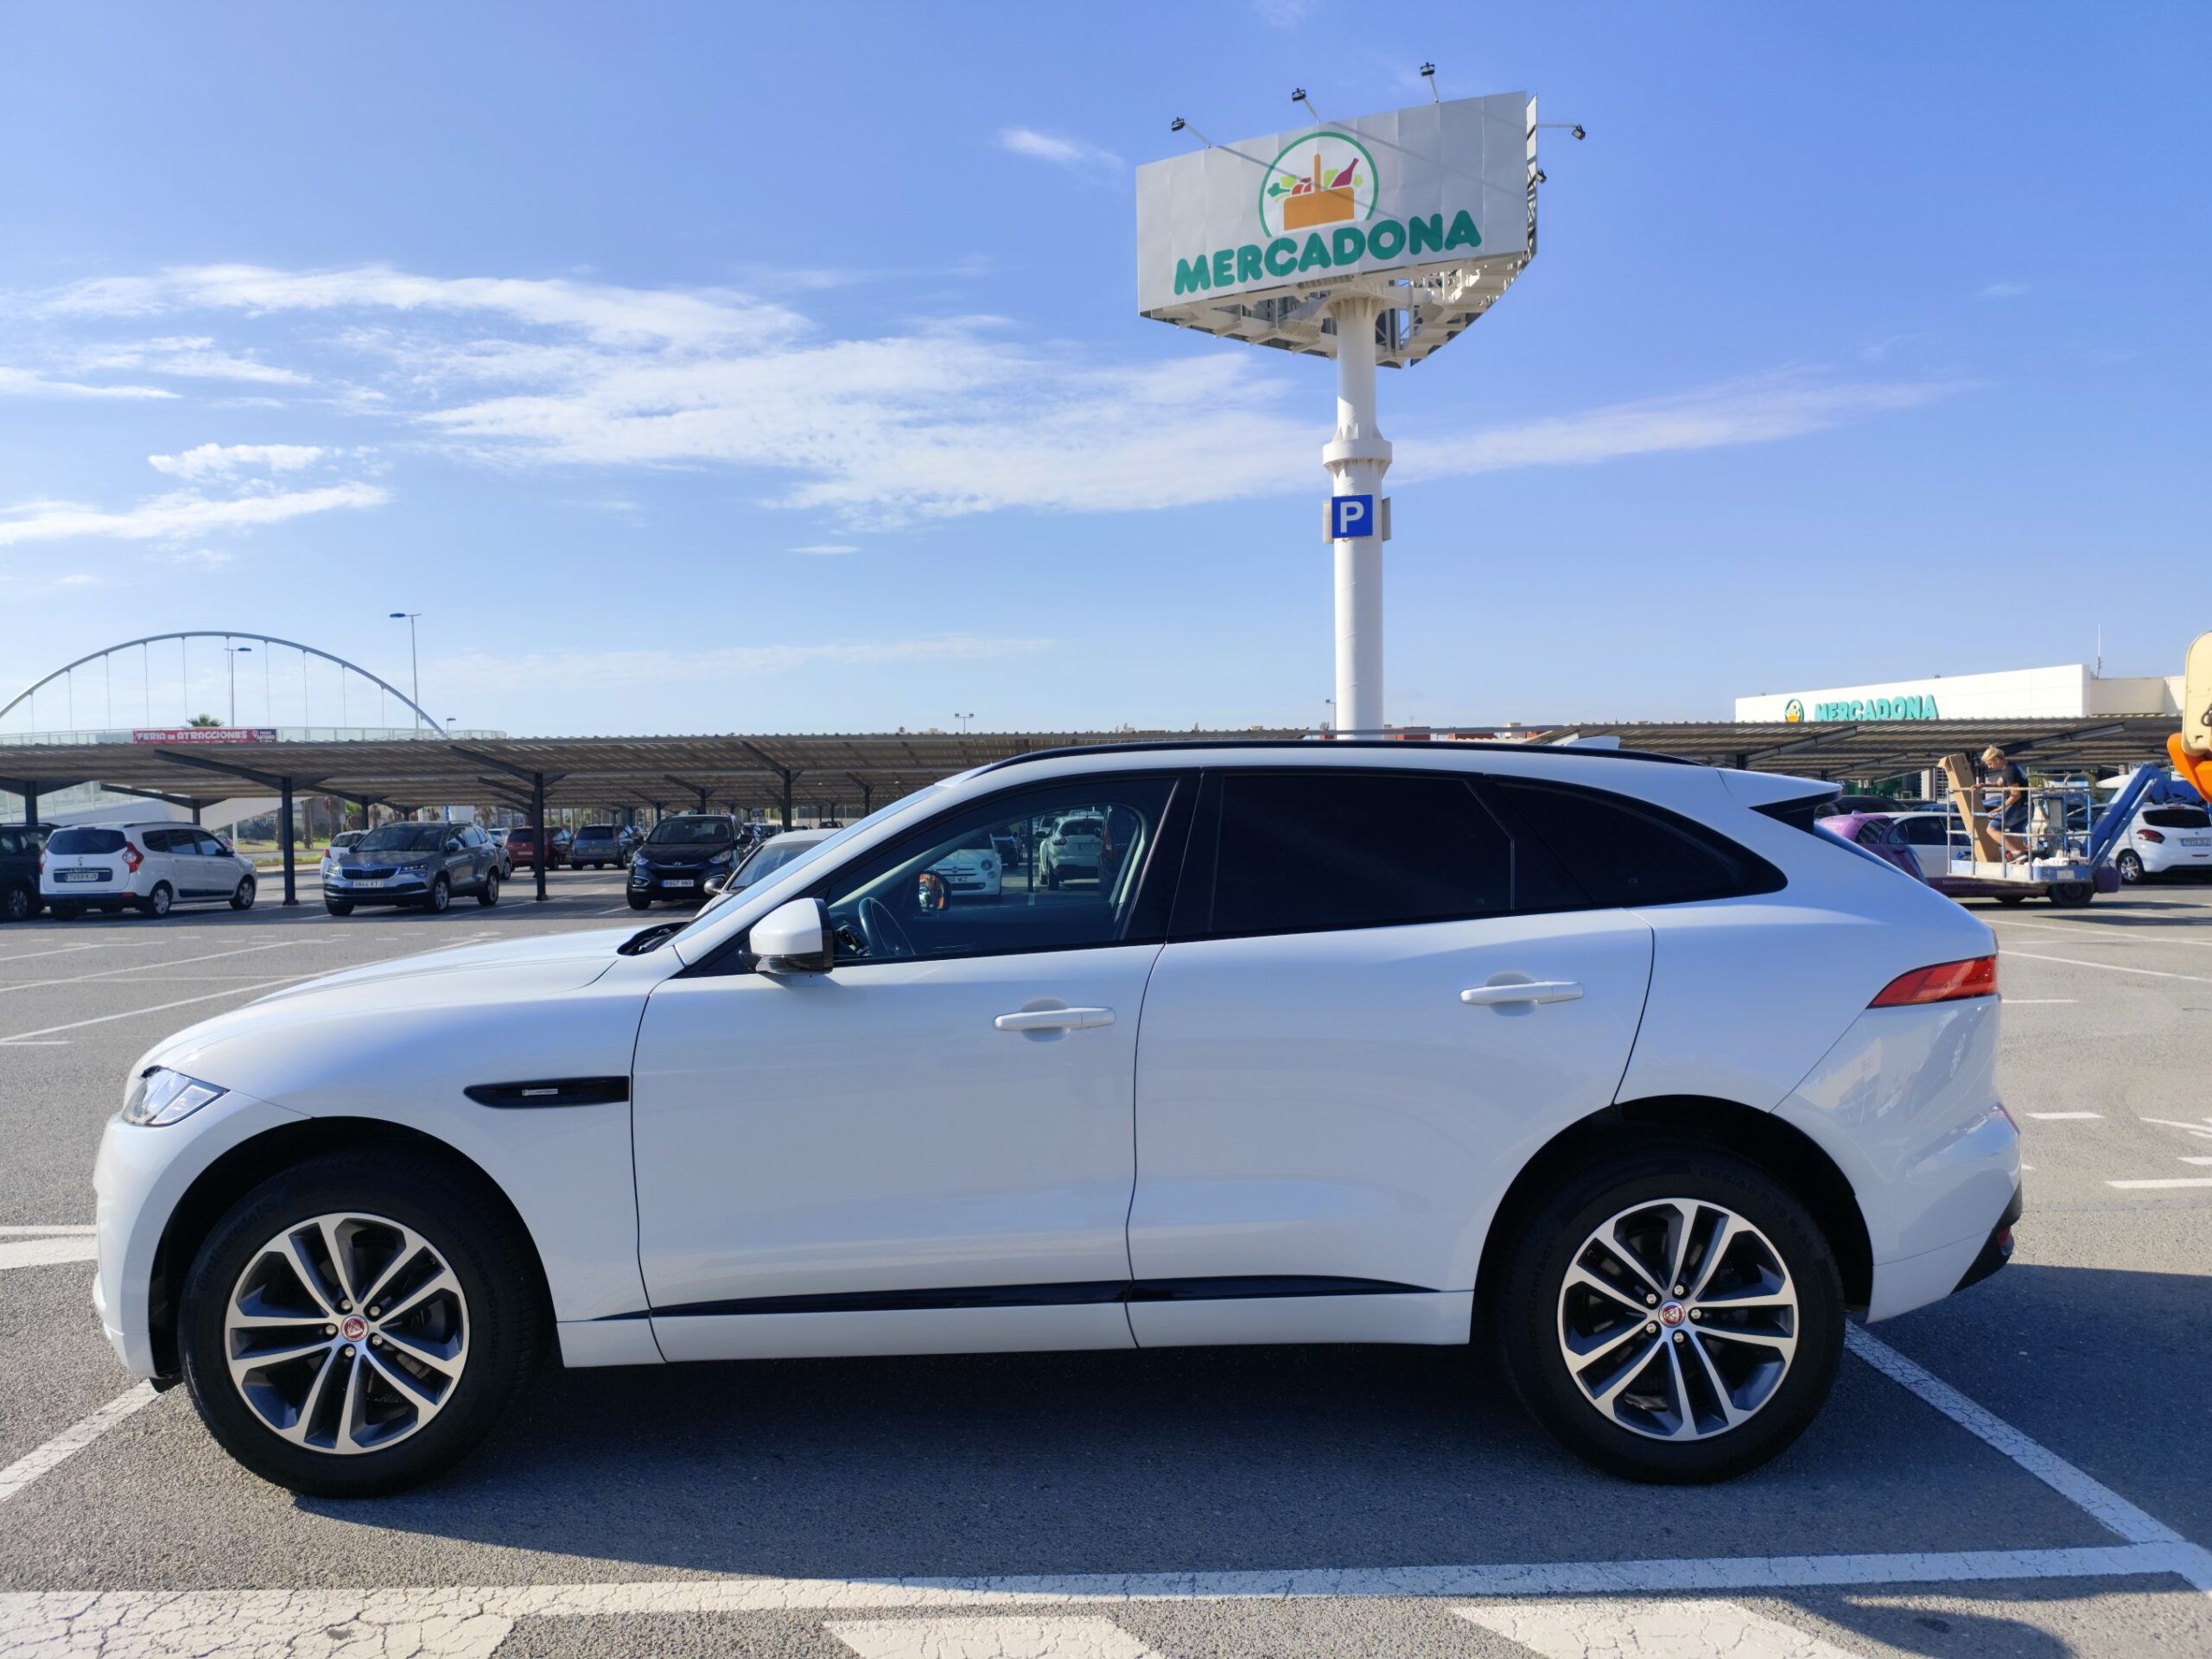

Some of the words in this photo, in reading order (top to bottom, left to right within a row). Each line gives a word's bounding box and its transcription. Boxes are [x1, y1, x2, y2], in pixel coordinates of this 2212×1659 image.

[1174, 210, 1481, 296] MERCADONA
[1340, 501, 1364, 533] P
[1815, 694, 1940, 720] MERCADONA
[177, 730, 248, 741] ATRACCIONES
